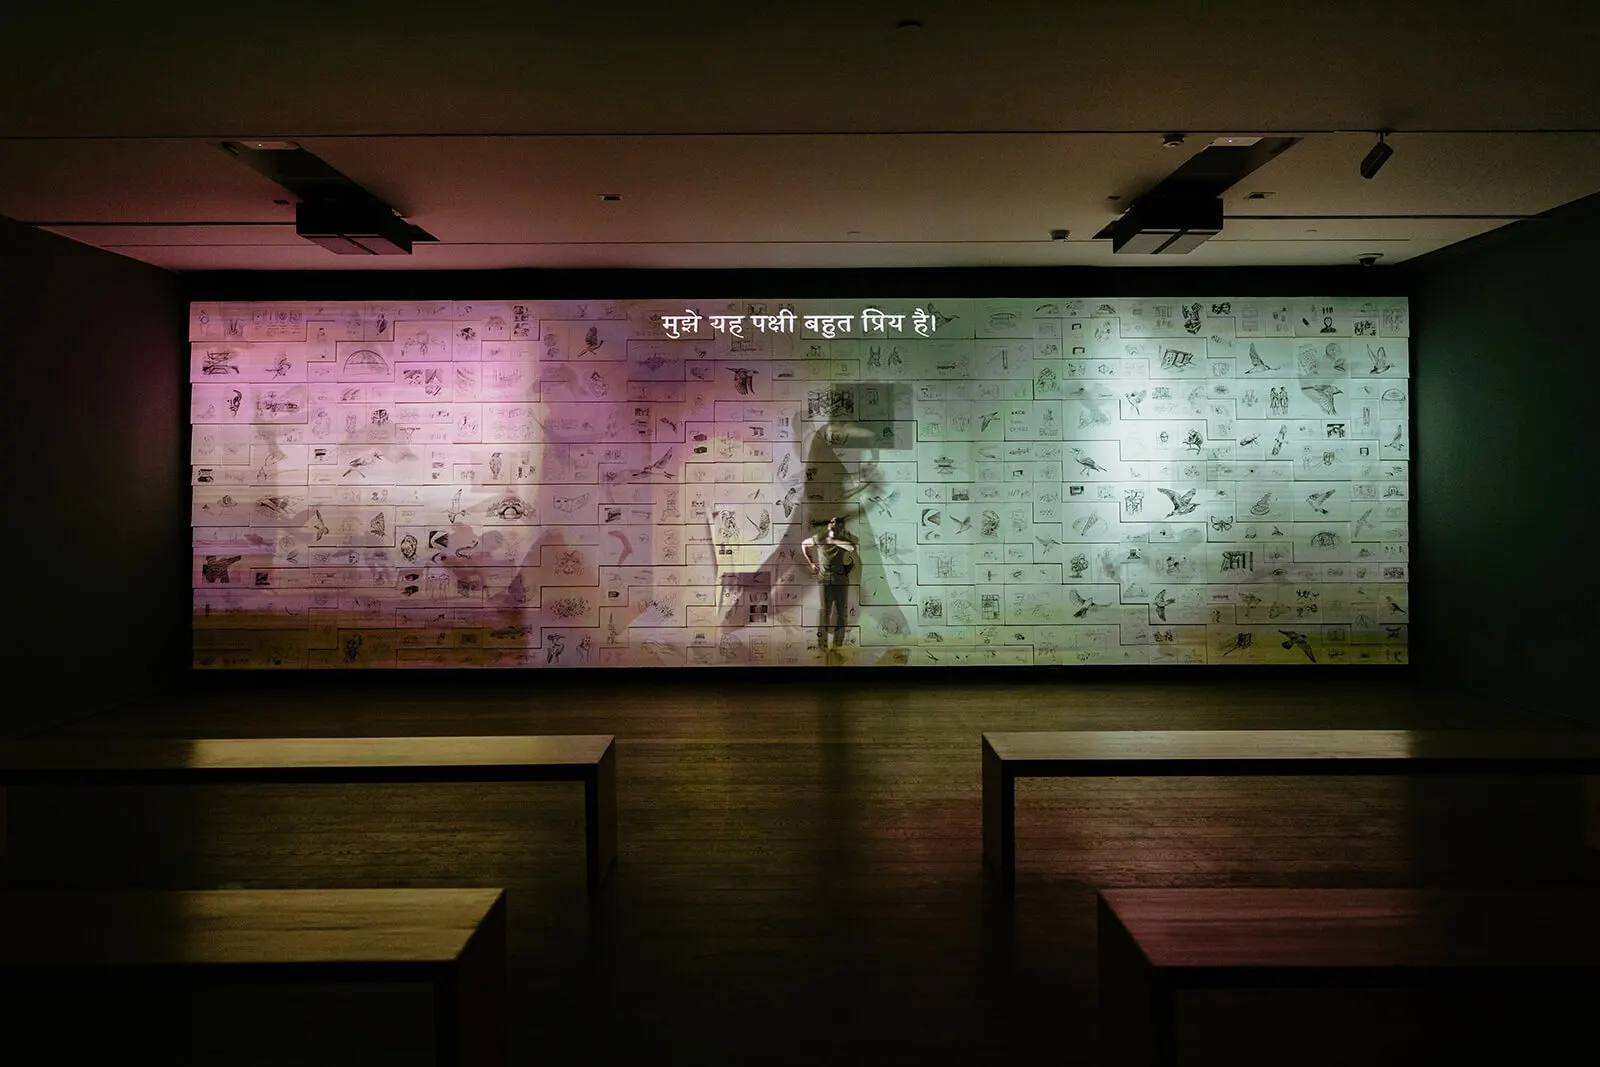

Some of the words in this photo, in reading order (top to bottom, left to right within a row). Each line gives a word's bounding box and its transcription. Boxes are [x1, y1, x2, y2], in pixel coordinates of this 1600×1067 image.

[661, 309, 703, 339] मुझे
[708, 315, 746, 339] यह
[750, 308, 798, 333] पक्षी
[803, 315, 855, 339] बहुत
[860, 308, 906, 333] प्रिय
[911, 308, 937, 338] है।
